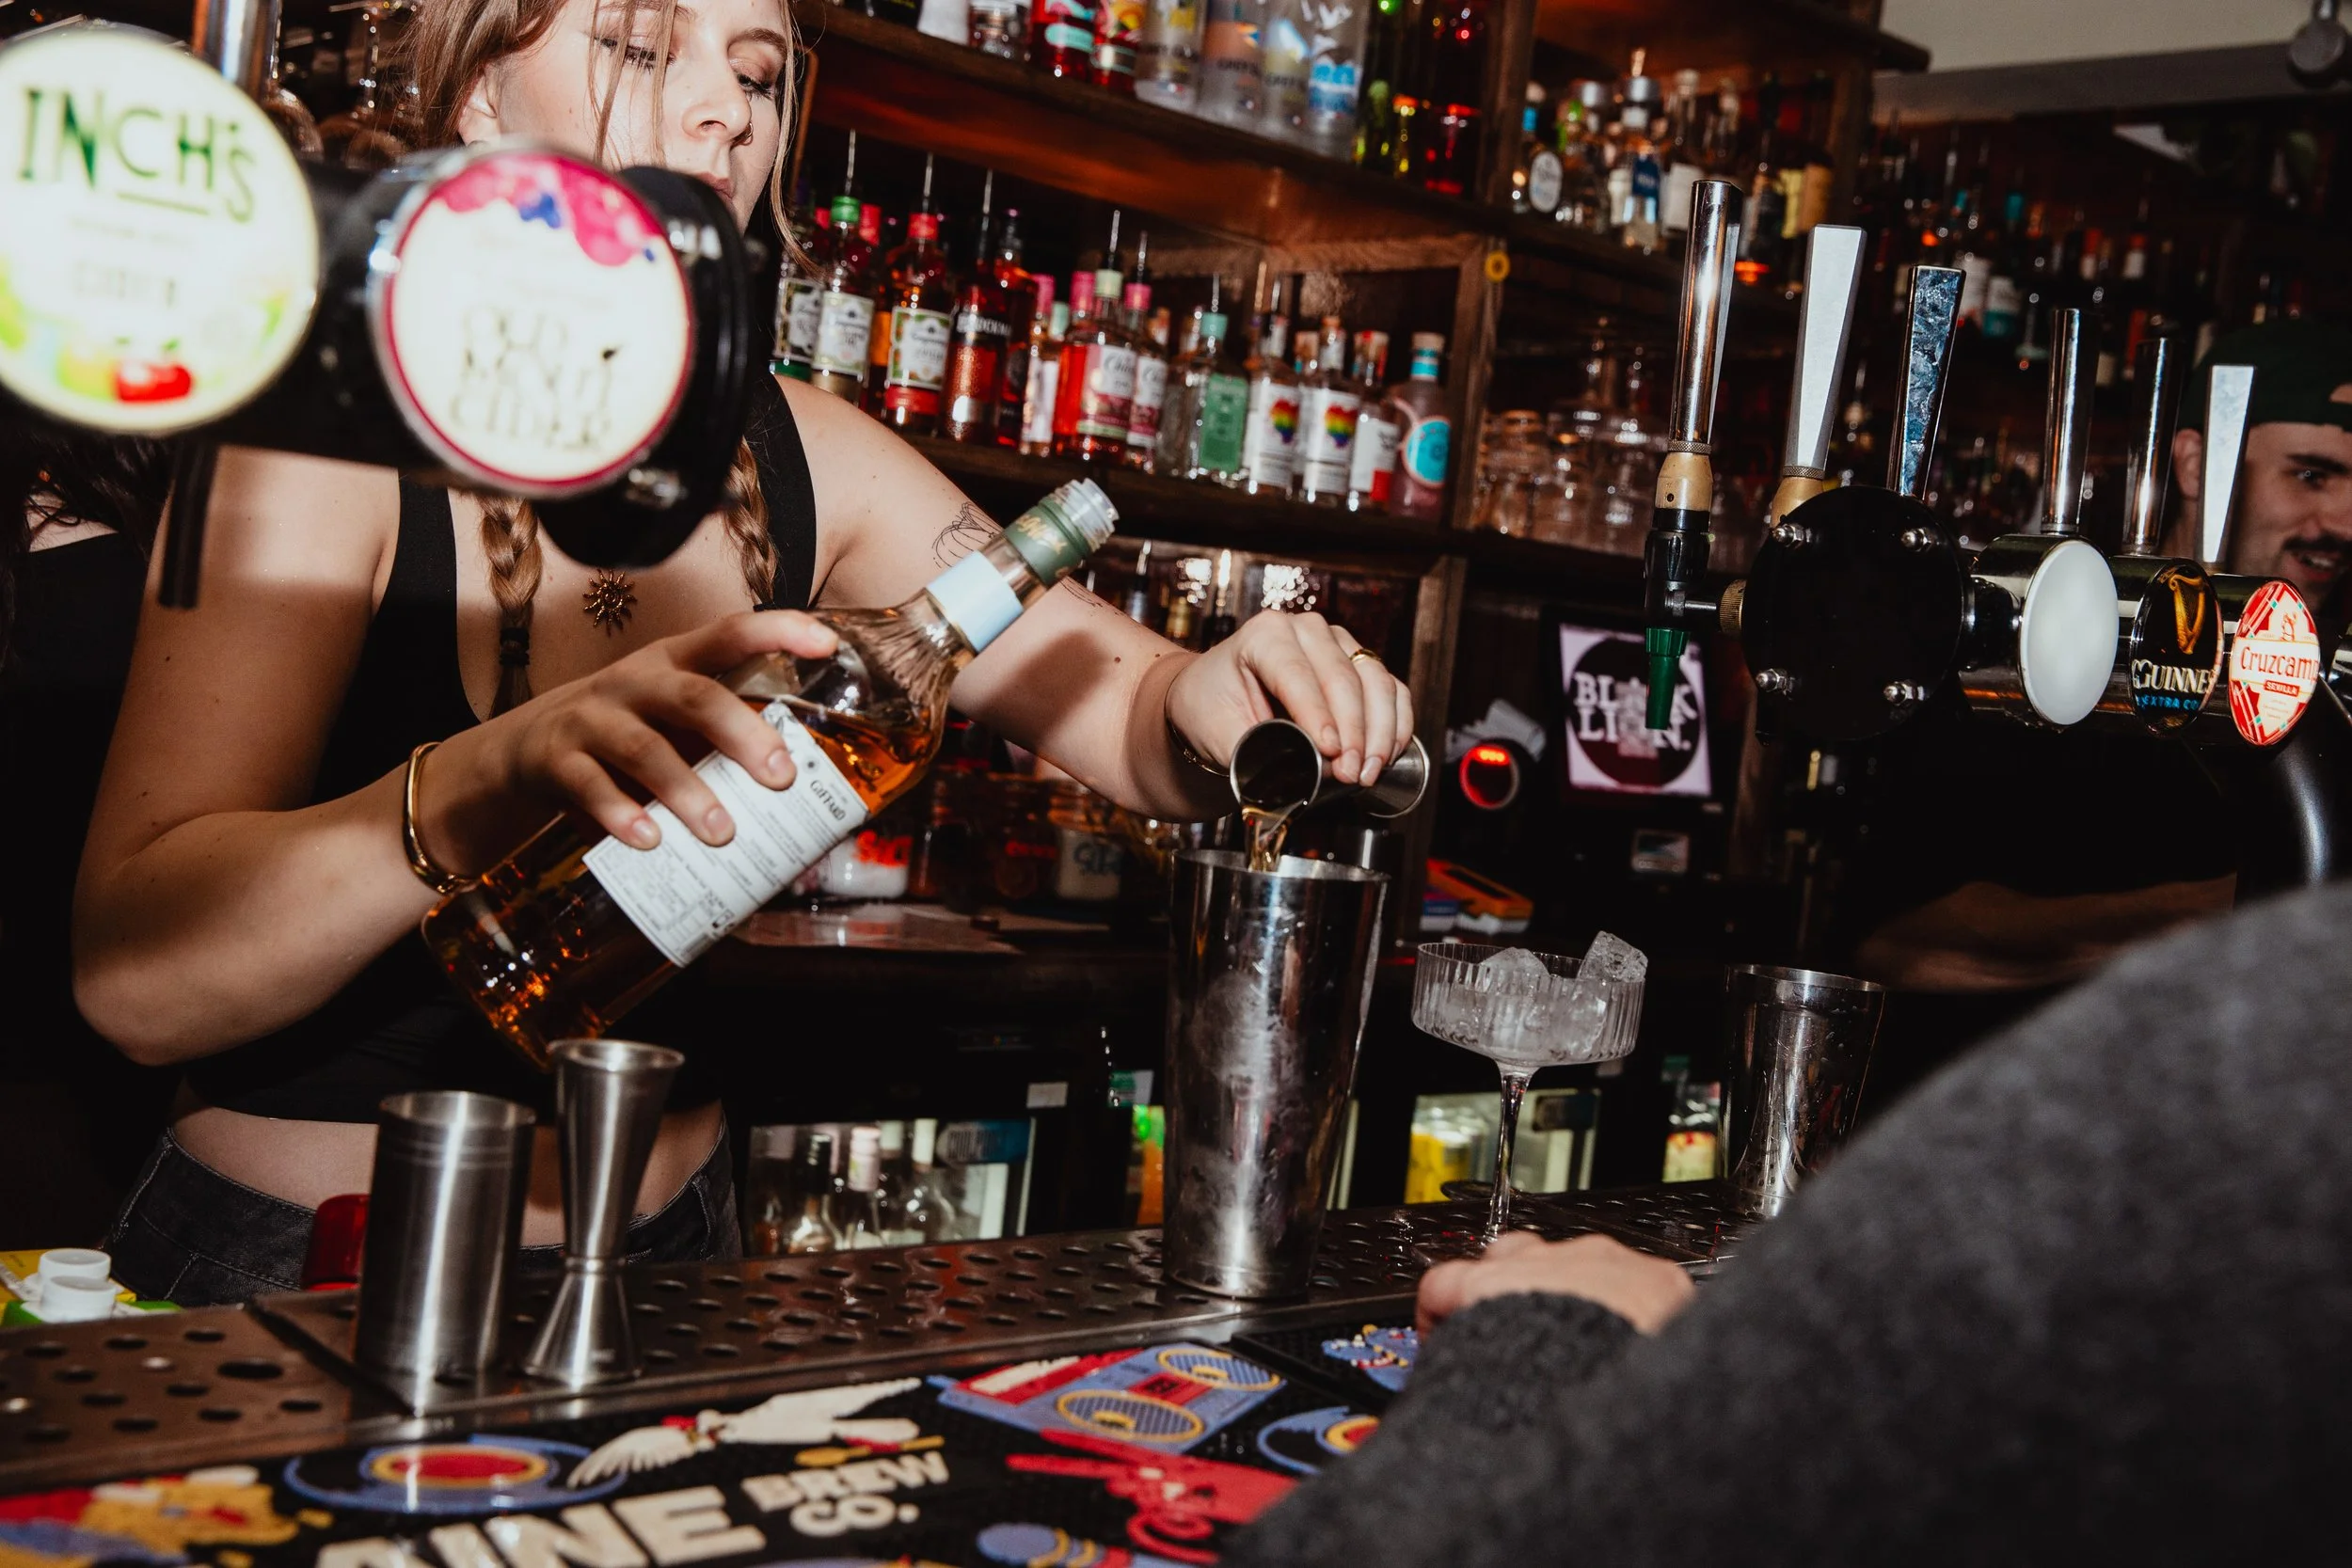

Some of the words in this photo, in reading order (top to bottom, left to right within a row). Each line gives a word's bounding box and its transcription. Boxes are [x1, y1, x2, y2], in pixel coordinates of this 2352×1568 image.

[2240, 646, 2319, 684] Cruzcamp
[2141, 695, 2180, 708] EXTRA
[2266, 682, 2297, 695] SEVILLA
[740, 1449, 950, 1513] BREW
[789, 1494, 920, 1537] CO.
